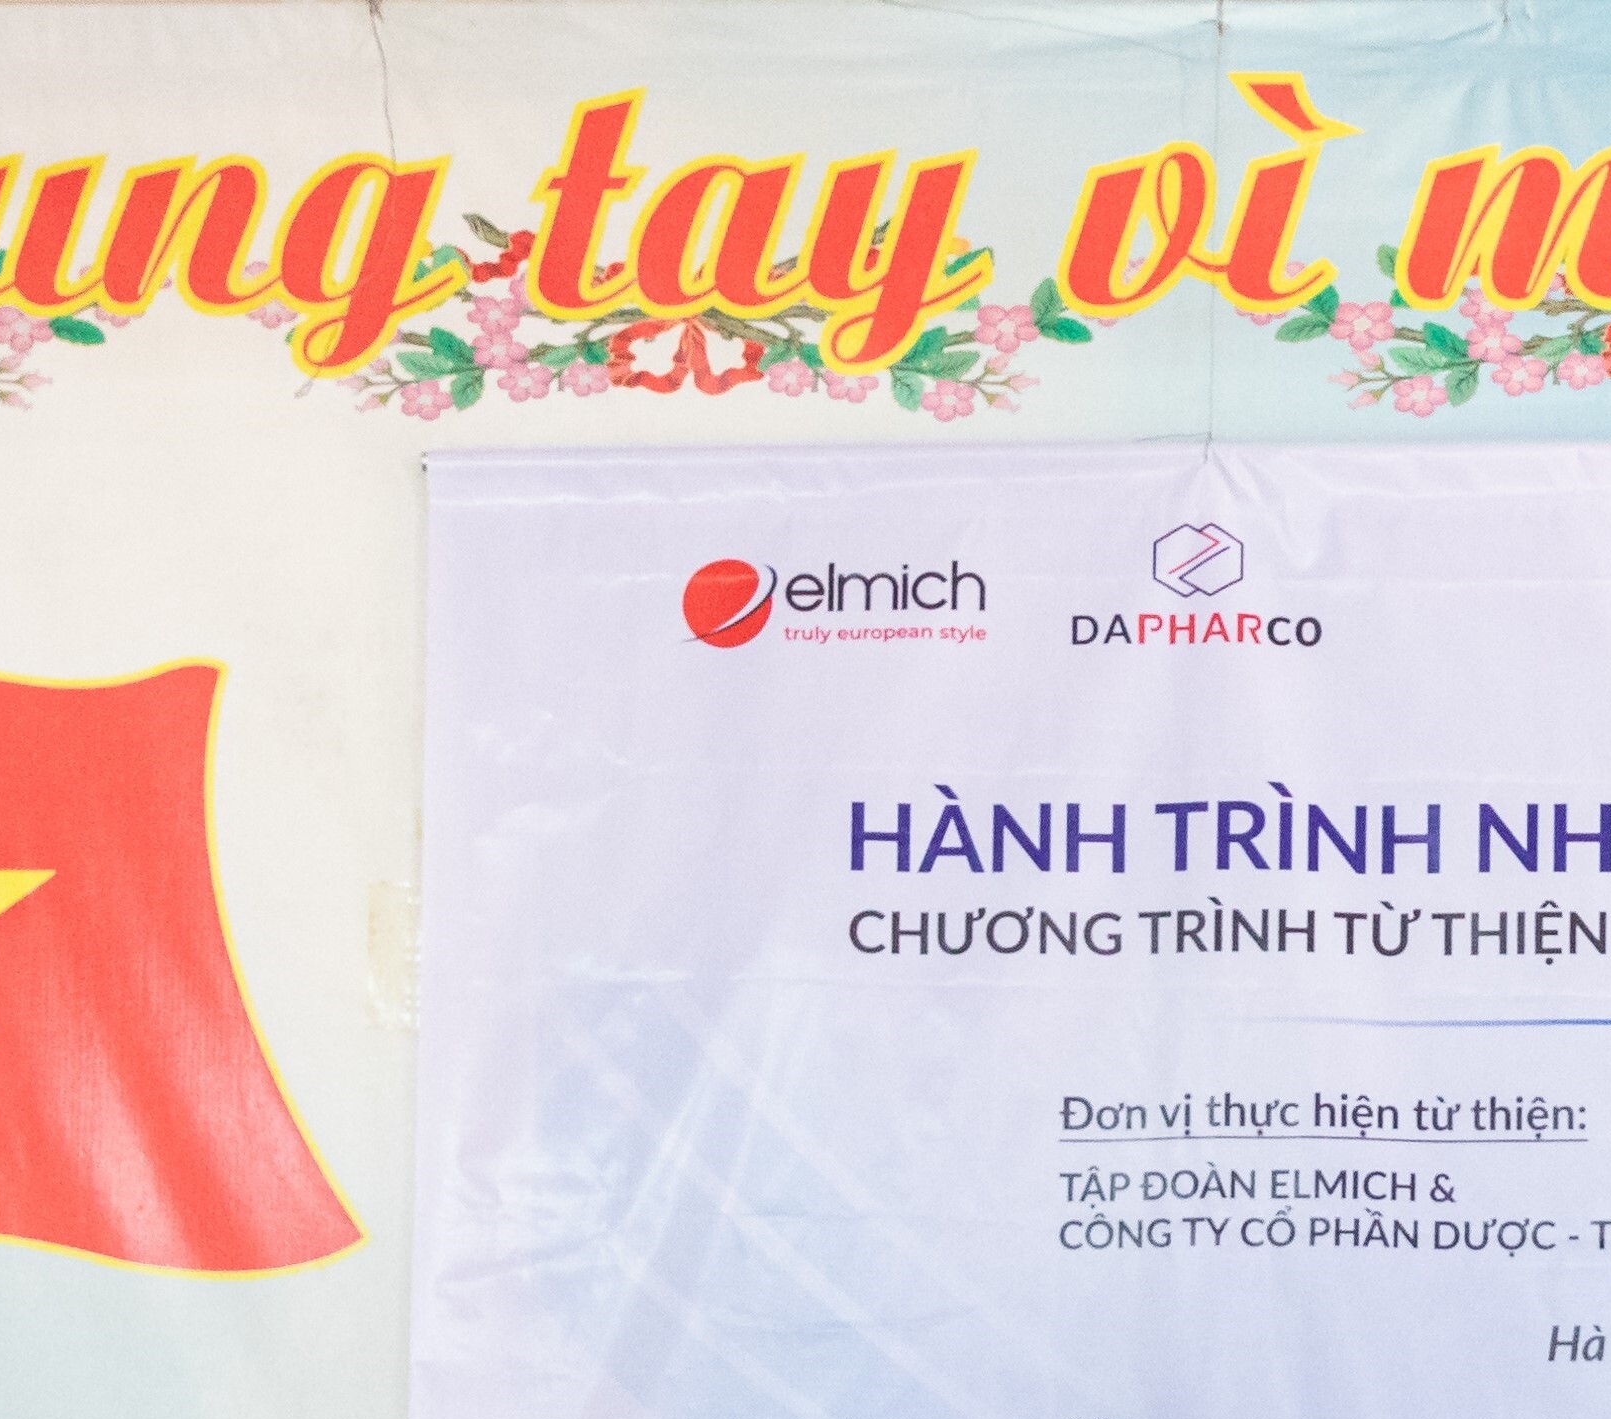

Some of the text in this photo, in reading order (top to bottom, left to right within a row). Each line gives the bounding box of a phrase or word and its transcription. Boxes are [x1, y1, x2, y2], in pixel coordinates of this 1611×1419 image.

[516, 87, 992, 374] tay
[1060, 71, 1360, 316] vì
[785, 561, 986, 611] elmich
[784, 624, 987, 644] truly european style
[1071, 612, 1322, 647] DAPHARCO
[849, 783, 1127, 875] HÀNH
[1153, 780, 1442, 876] TRÌNH
[847, 905, 1123, 957] CHƯƠNG
[1137, 895, 1317, 956] TRÌNH
[1332, 901, 1427, 958] TỪ
[1434, 899, 1608, 967] THIỆN
[1058, 1091, 1587, 1136] Đơn vị thực hiện từ thiện:
[1058, 1162, 1457, 1210] TẬP ĐOÀN ELMICH &
[1058, 1212, 1173, 1251] CÔNG
[1180, 1215, 1231, 1247] TY
[1239, 1208, 1297, 1249] CỔ
[1308, 1208, 1420, 1250] PHẦN
[1432, 1217, 1557, 1259] DƯỢC
[1567, 1234, 1580, 1242] -
[1547, 1324, 1607, 1363] Hà
